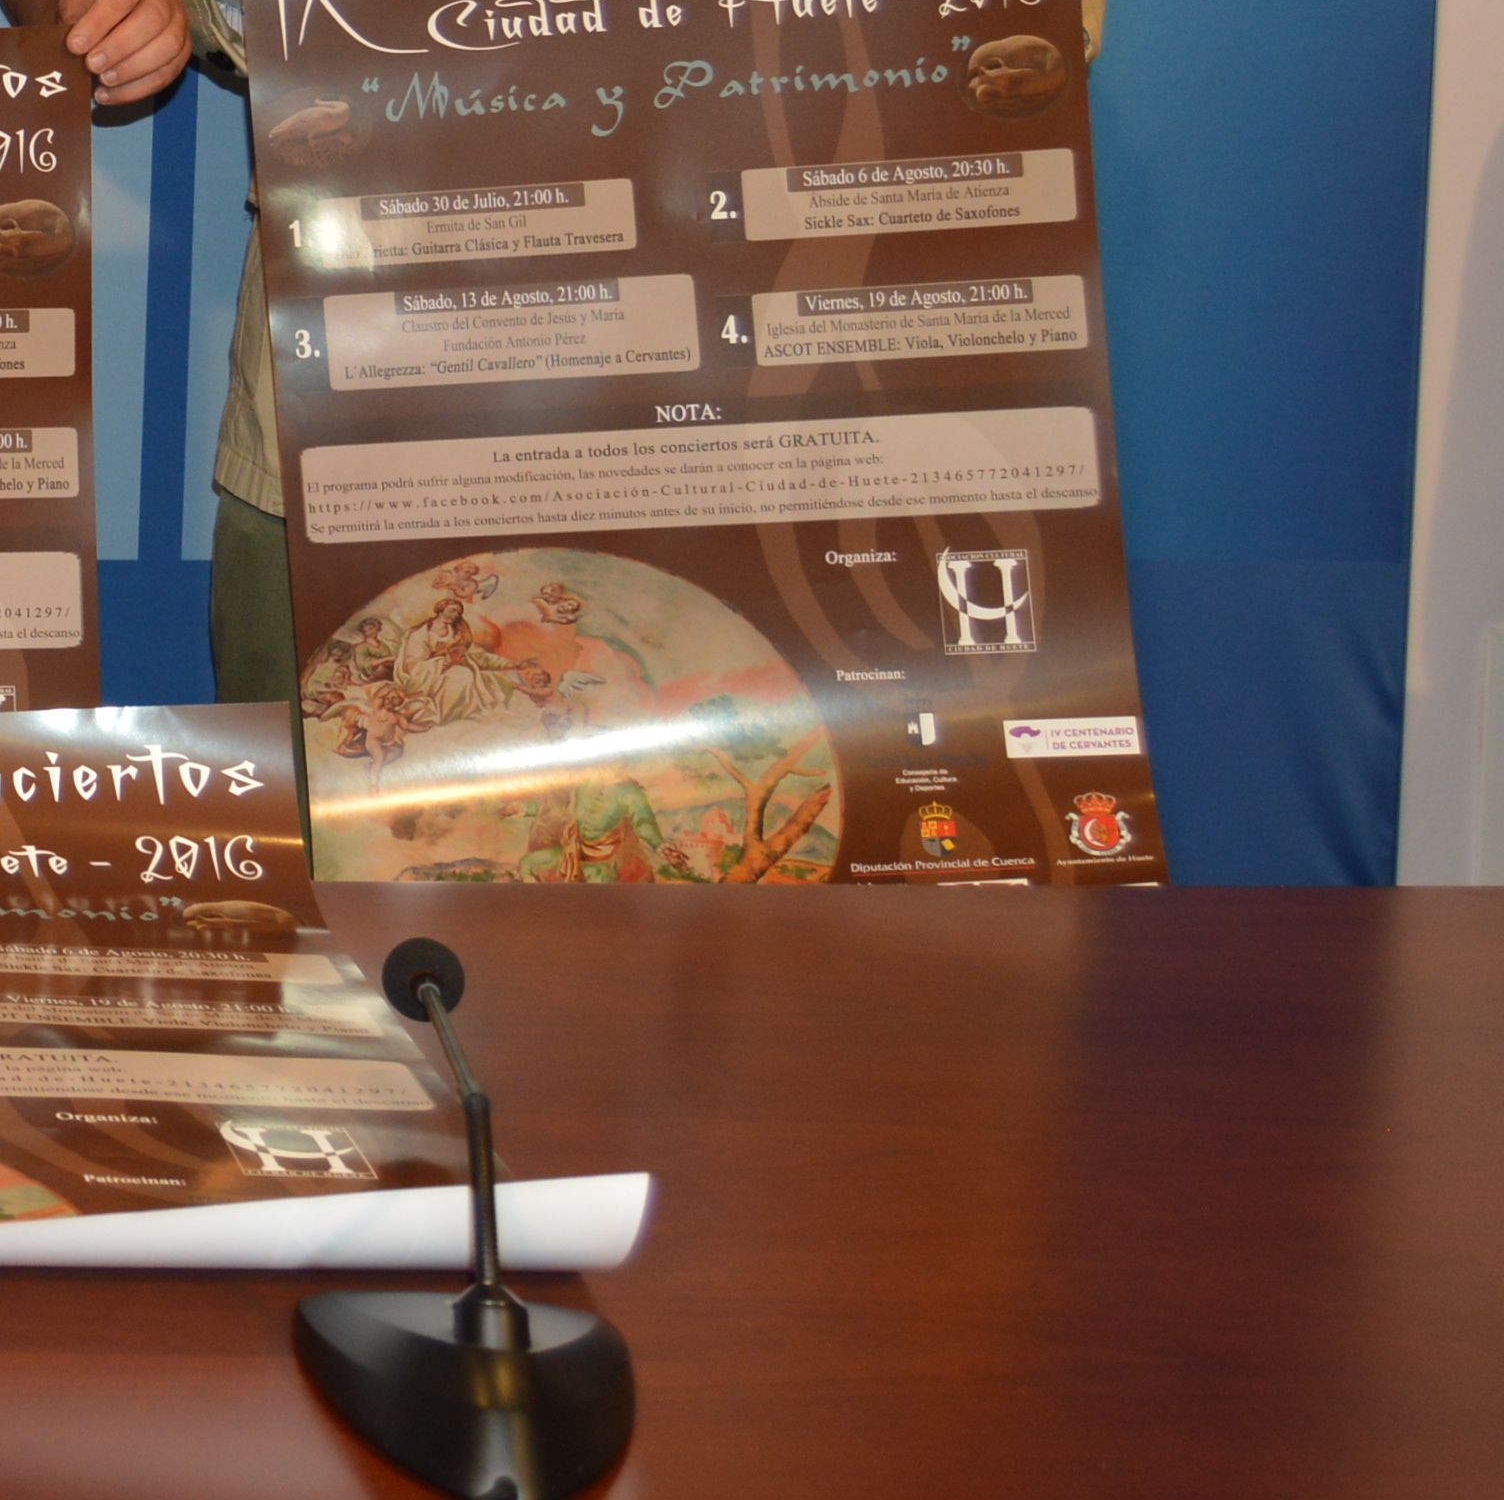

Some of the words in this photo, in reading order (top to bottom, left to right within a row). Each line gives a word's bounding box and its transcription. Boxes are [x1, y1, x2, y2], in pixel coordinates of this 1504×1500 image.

[804, 293, 864, 312] Viernes,
[869, 292, 884, 308] 19
[889, 291, 907, 307] de
[910, 288, 966, 309] Agosto,
[970, 286, 1010, 303] 21:00
[1014, 284, 1028, 300] h.
[764, 342, 812, 359] ASCOT
[817, 338, 901, 356] ENSEMBLE:
[904, 335, 944, 352] Viola,
[948, 331, 1025, 349] Violonchelo
[1029, 334, 1036, 346] y
[1041, 328, 1077, 343] Piano
[655, 402, 722, 423] NOTA:
[825, 549, 897, 567] Organiza:
[836, 668, 906, 682] Patrocinan:
[1050, 729, 1061, 737] IV
[1064, 727, 1134, 737] CENTENARIO
[1052, 741, 1067, 750] DE
[1070, 740, 1132, 749] CERVANTES
[134, 834, 263, 882] 2016
[851, 861, 912, 874] Diputación
[915, 859, 970, 869] Provincial
[973, 858, 989, 868] de
[992, 857, 1034, 867] Cuenca
[55, 1111, 158, 1125] Organiza:
